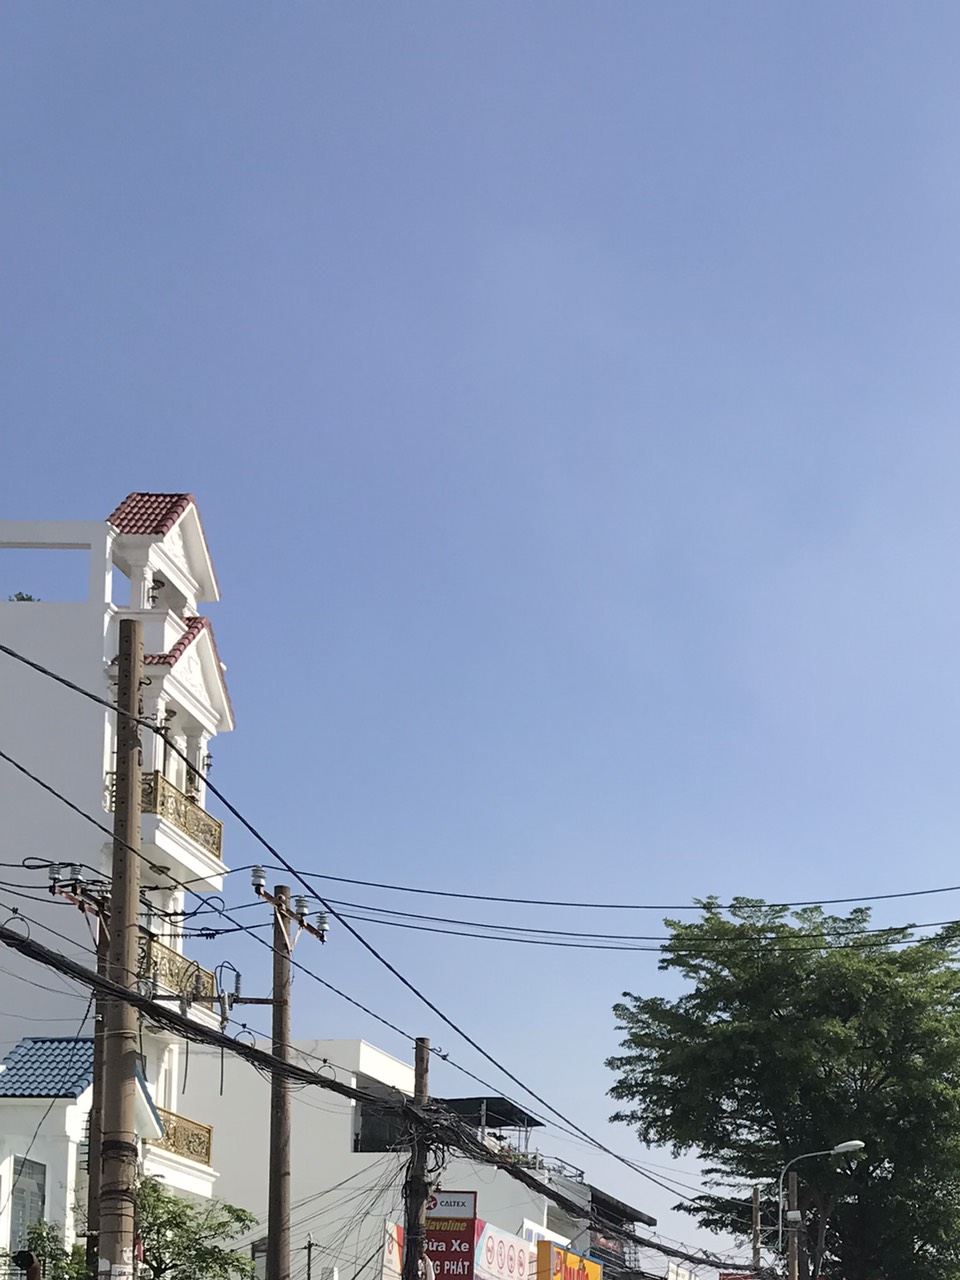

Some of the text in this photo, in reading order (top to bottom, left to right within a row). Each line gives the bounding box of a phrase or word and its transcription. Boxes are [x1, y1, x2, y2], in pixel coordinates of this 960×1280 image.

[439, 1200, 467, 1208] CALTEX
[450, 1239, 470, 1252] Xe
[443, 1258, 470, 1275] PHÁT
